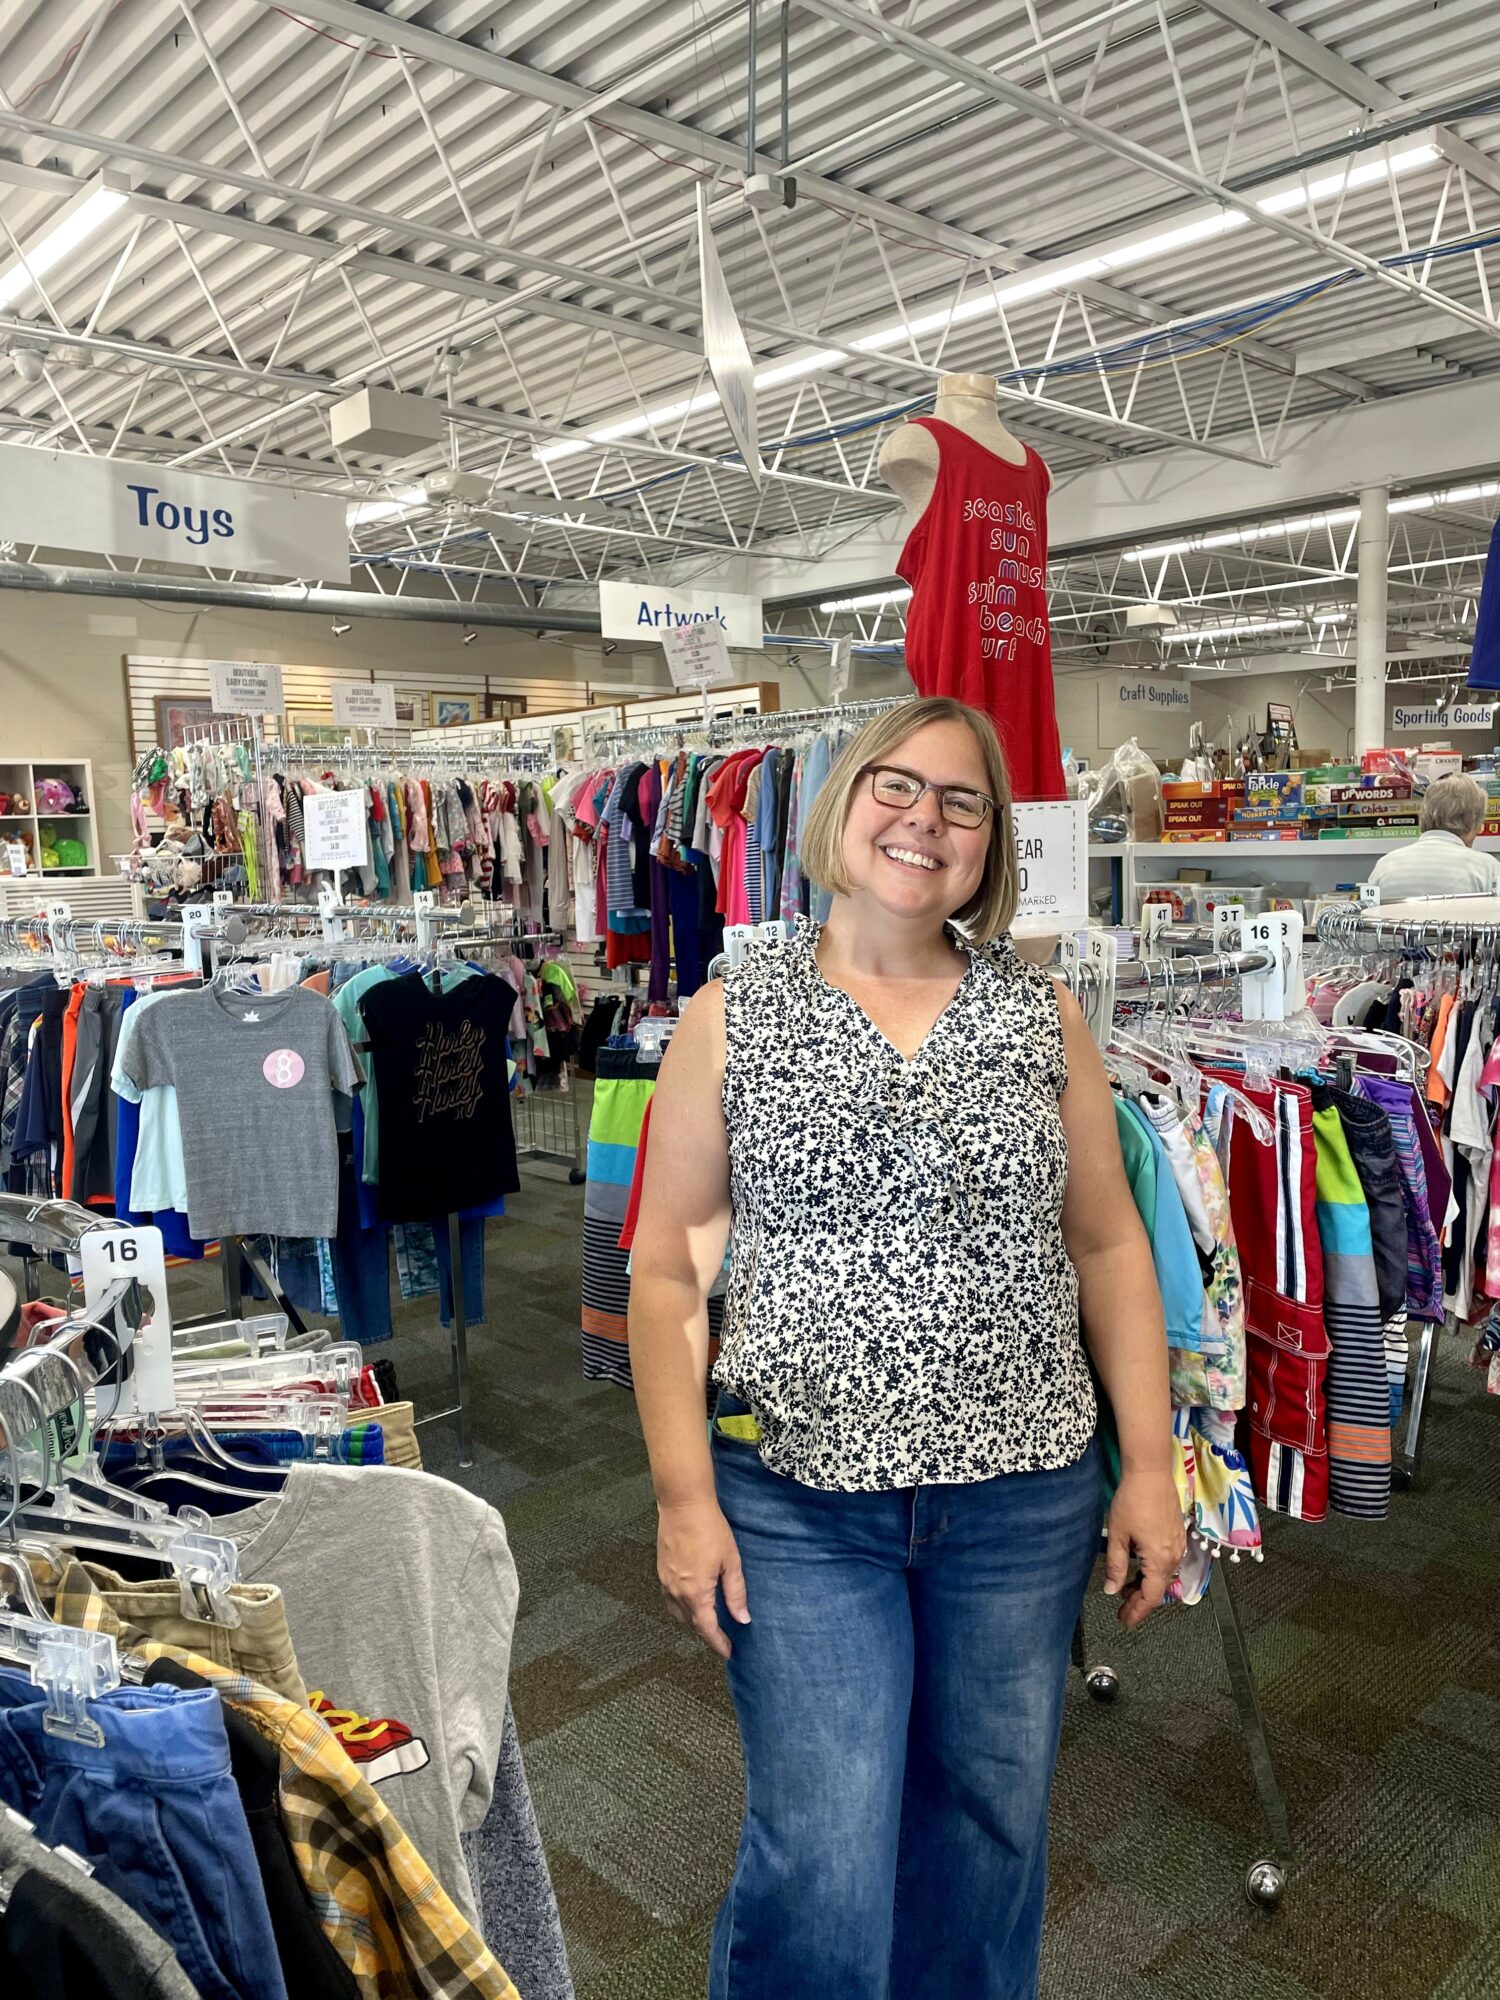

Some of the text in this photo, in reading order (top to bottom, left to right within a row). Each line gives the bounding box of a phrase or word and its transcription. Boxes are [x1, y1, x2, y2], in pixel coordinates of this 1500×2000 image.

[127, 484, 235, 545] Toys
[990, 529, 1029, 558] sun
[980, 605, 1046, 645] beach
[1120, 684, 1189, 706] Craft Supplies
[1395, 703, 1491, 728] Sporting Goods
[1341, 788, 1394, 800] UPWORDS
[1170, 801, 1203, 809] SPEAK OUT
[1188, 815, 1203, 823] OUT
[1016, 838, 1043, 860] EAR
[419, 895, 428, 903] 14
[1366, 889, 1375, 897] 10
[53, 907, 64, 916] 16
[189, 910, 202, 920] 20
[1157, 909, 1167, 921] 4T
[766, 926, 778, 937] 12
[1251, 925, 1270, 940] 16
[1065, 942, 1074, 957] 10
[1092, 940, 1102, 957] 12
[415, 1019, 487, 1068] Hurley
[413, 1046, 485, 1095] Hurley
[412, 1075, 484, 1124] Hurley
[101, 1238, 138, 1263] 16
